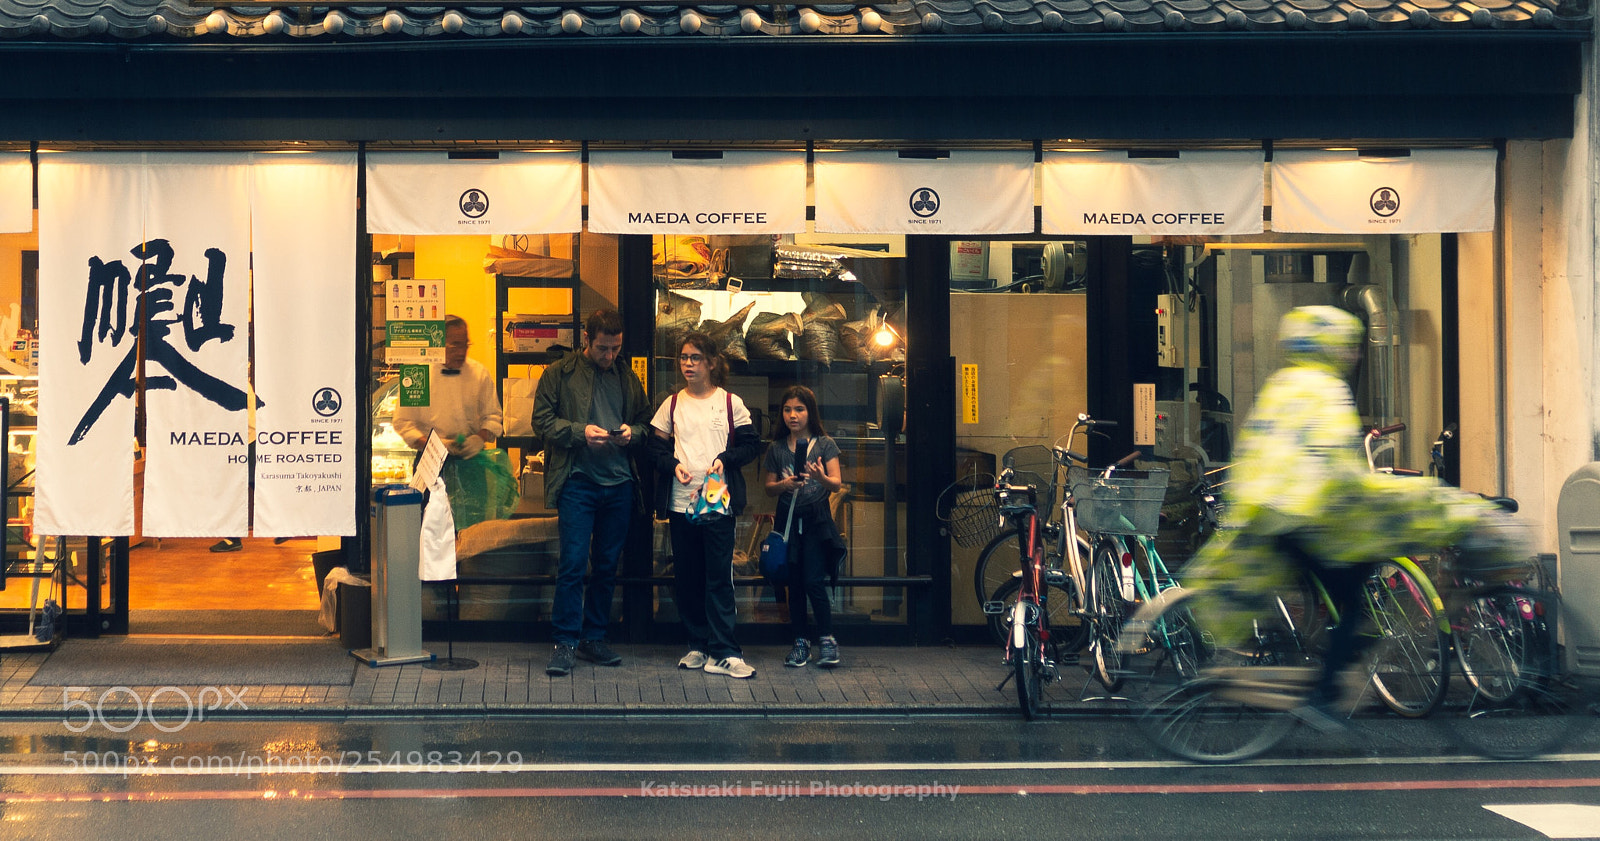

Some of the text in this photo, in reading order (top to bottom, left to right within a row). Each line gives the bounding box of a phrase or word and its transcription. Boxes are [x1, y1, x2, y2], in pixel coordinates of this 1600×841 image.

[628, 213, 767, 224] MAEDA COFFEE
[1083, 213, 1225, 225] MAEDA COFFEE
[170, 431, 342, 446] MAEDA COFFEE
[228, 453, 342, 464] HOME ROASTED
[261, 472, 342, 481] Karasuma Takoyakushi
[317, 485, 342, 493] JAPAN
